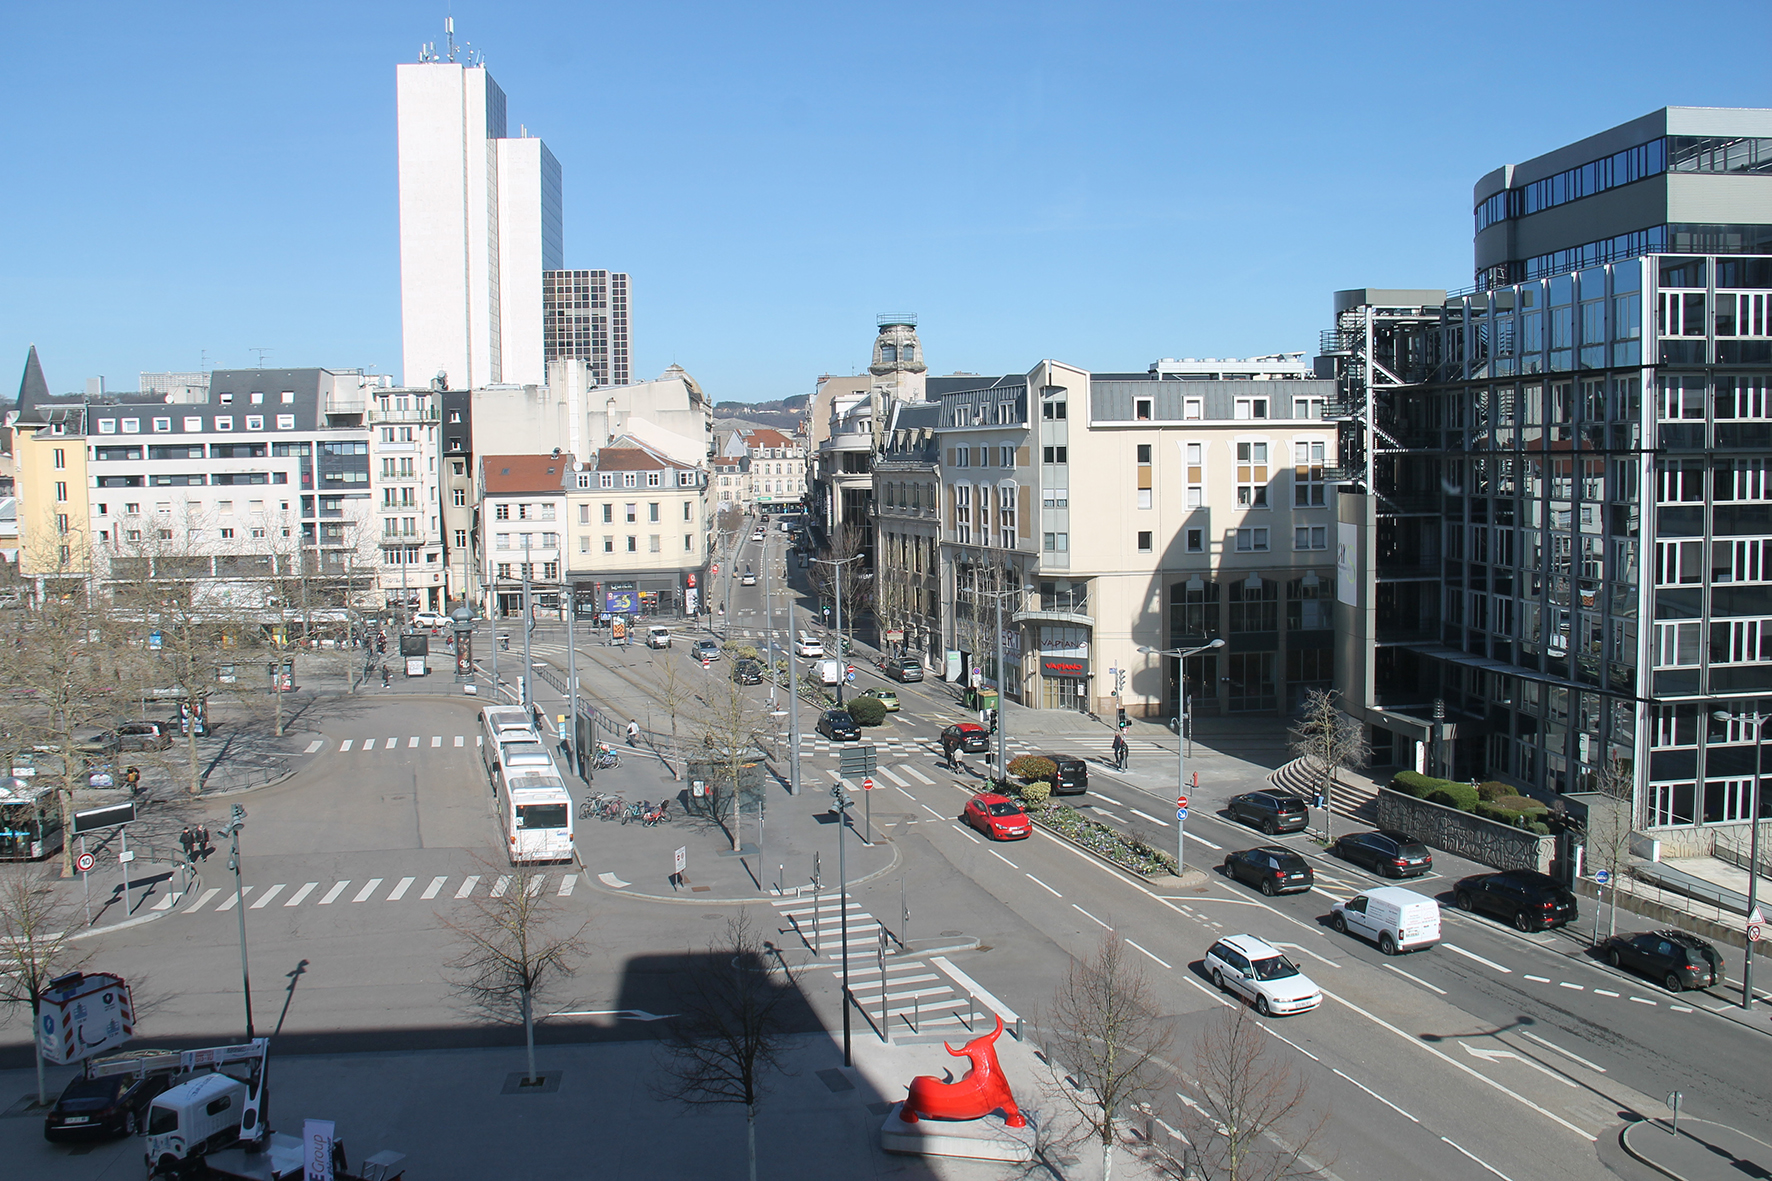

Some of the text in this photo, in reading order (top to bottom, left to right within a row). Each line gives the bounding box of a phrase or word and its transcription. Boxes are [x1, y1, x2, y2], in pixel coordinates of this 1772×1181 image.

[1040, 638, 1088, 649] VAPIANO
[1045, 661, 1083, 671] VAPIANO
[81, 857, 91, 866] 10
[311, 1134, 327, 1173] Group
